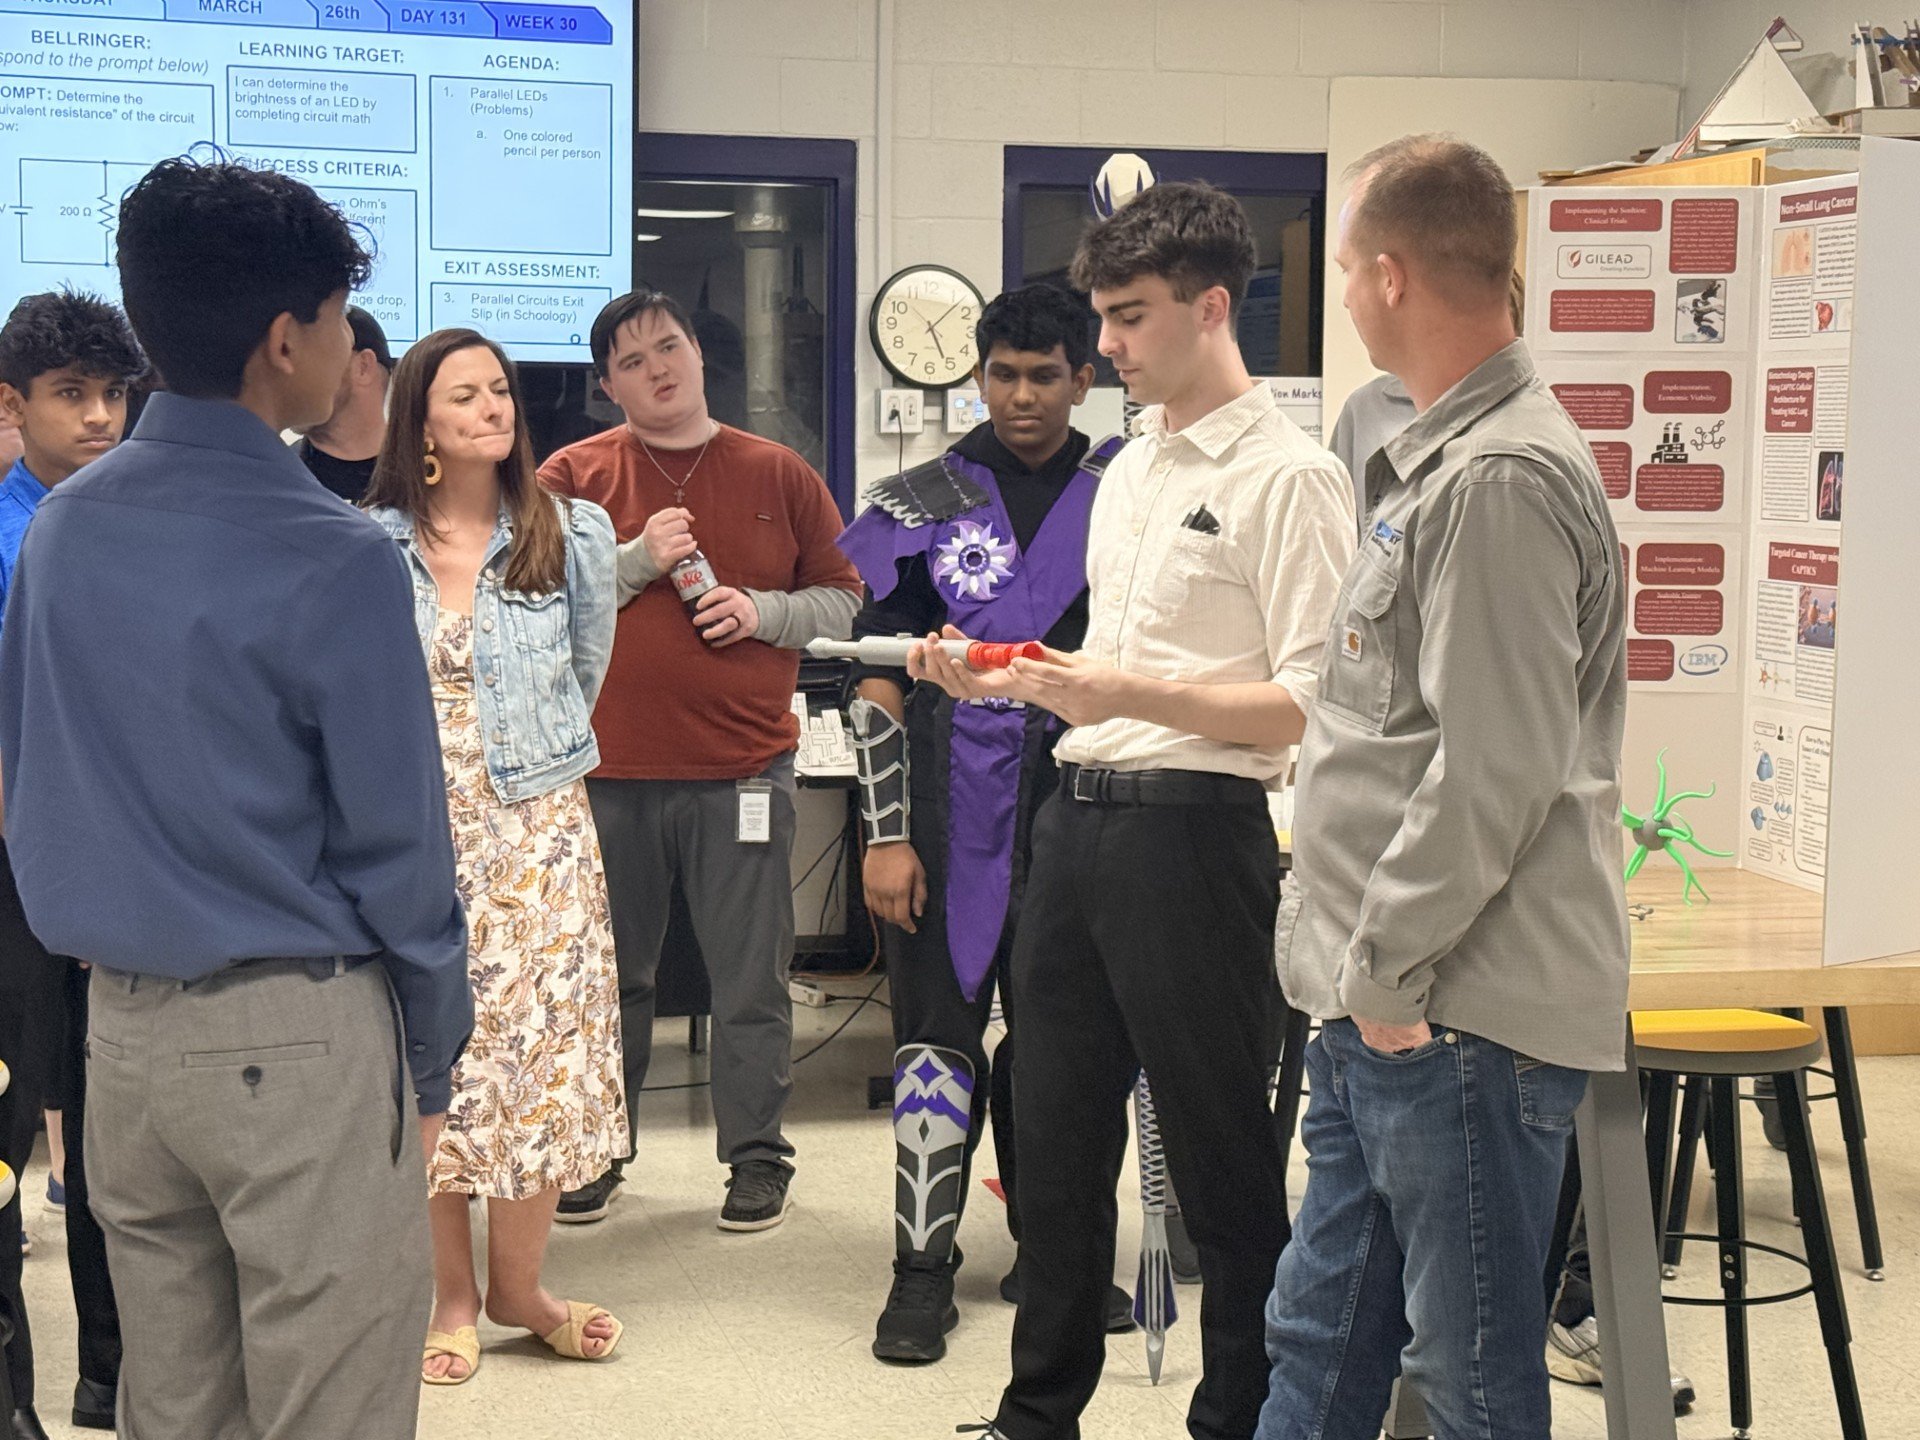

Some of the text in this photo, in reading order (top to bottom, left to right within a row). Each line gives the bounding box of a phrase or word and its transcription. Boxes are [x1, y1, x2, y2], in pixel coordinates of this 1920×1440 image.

[199, 0, 262, 15] MARCH
[325, 5, 360, 20] 26th
[401, 9, 466, 25] DAY 131
[505, 15, 577, 30] WEEK 30
[31, 30, 151, 50] BELLRINGER:
[239, 41, 404, 63] LEARNING TARGET:
[49, 52, 63, 66] to
[69, 53, 93, 67] the
[98, 57, 153, 74] prompt
[158, 57, 209, 75] below)
[484, 55, 559, 71] AGENDA:
[235, 76, 349, 92] I can determine the
[57, 90, 120, 104] Determine
[124, 92, 143, 105] the
[235, 92, 377, 110] brightness of an LED by
[444, 87, 548, 102] 1. Parallel LEDs
[50, 107, 117, 120] resistance"
[121, 110, 133, 121] of
[137, 110, 155, 122] the
[159, 112, 195, 124] circuit
[235, 108, 371, 124] completing circuit math
[470, 103, 533, 118] (Problems)
[476, 130, 572, 143] a. One colored
[504, 146, 601, 161] pencil per person
[324, 161, 408, 178] CRITERIA:
[349, 197, 387, 210] Ohm's
[1814, 200, 1830, 212] Lung
[1831, 197, 1855, 209] Cancer
[60, 206, 79, 216] 200
[1585, 253, 1633, 264] GILEAD
[445, 261, 600, 279] EXIT ASSESSMENT:
[907, 286, 919, 300] 11
[924, 281, 939, 294] 12
[377, 294, 407, 307] drop,
[444, 293, 584, 307] 3. Parallel Circuits Exit
[891, 301, 908, 314] 10
[961, 306, 971, 320] 2
[472, 309, 577, 323] Slip (in Schoology)
[887, 317, 897, 329] 9
[966, 325, 976, 339] 3
[893, 335, 904, 349] 8
[960, 344, 969, 357] 4
[908, 353, 917, 366] 7
[945, 357, 955, 371] 5
[924, 361, 935, 375] 6
[1292, 388, 1322, 399] Marks
[1791, 548, 1808, 560] Cancer
[1808, 550, 1827, 563] Therapy
[1688, 653, 1717, 666] IBM
